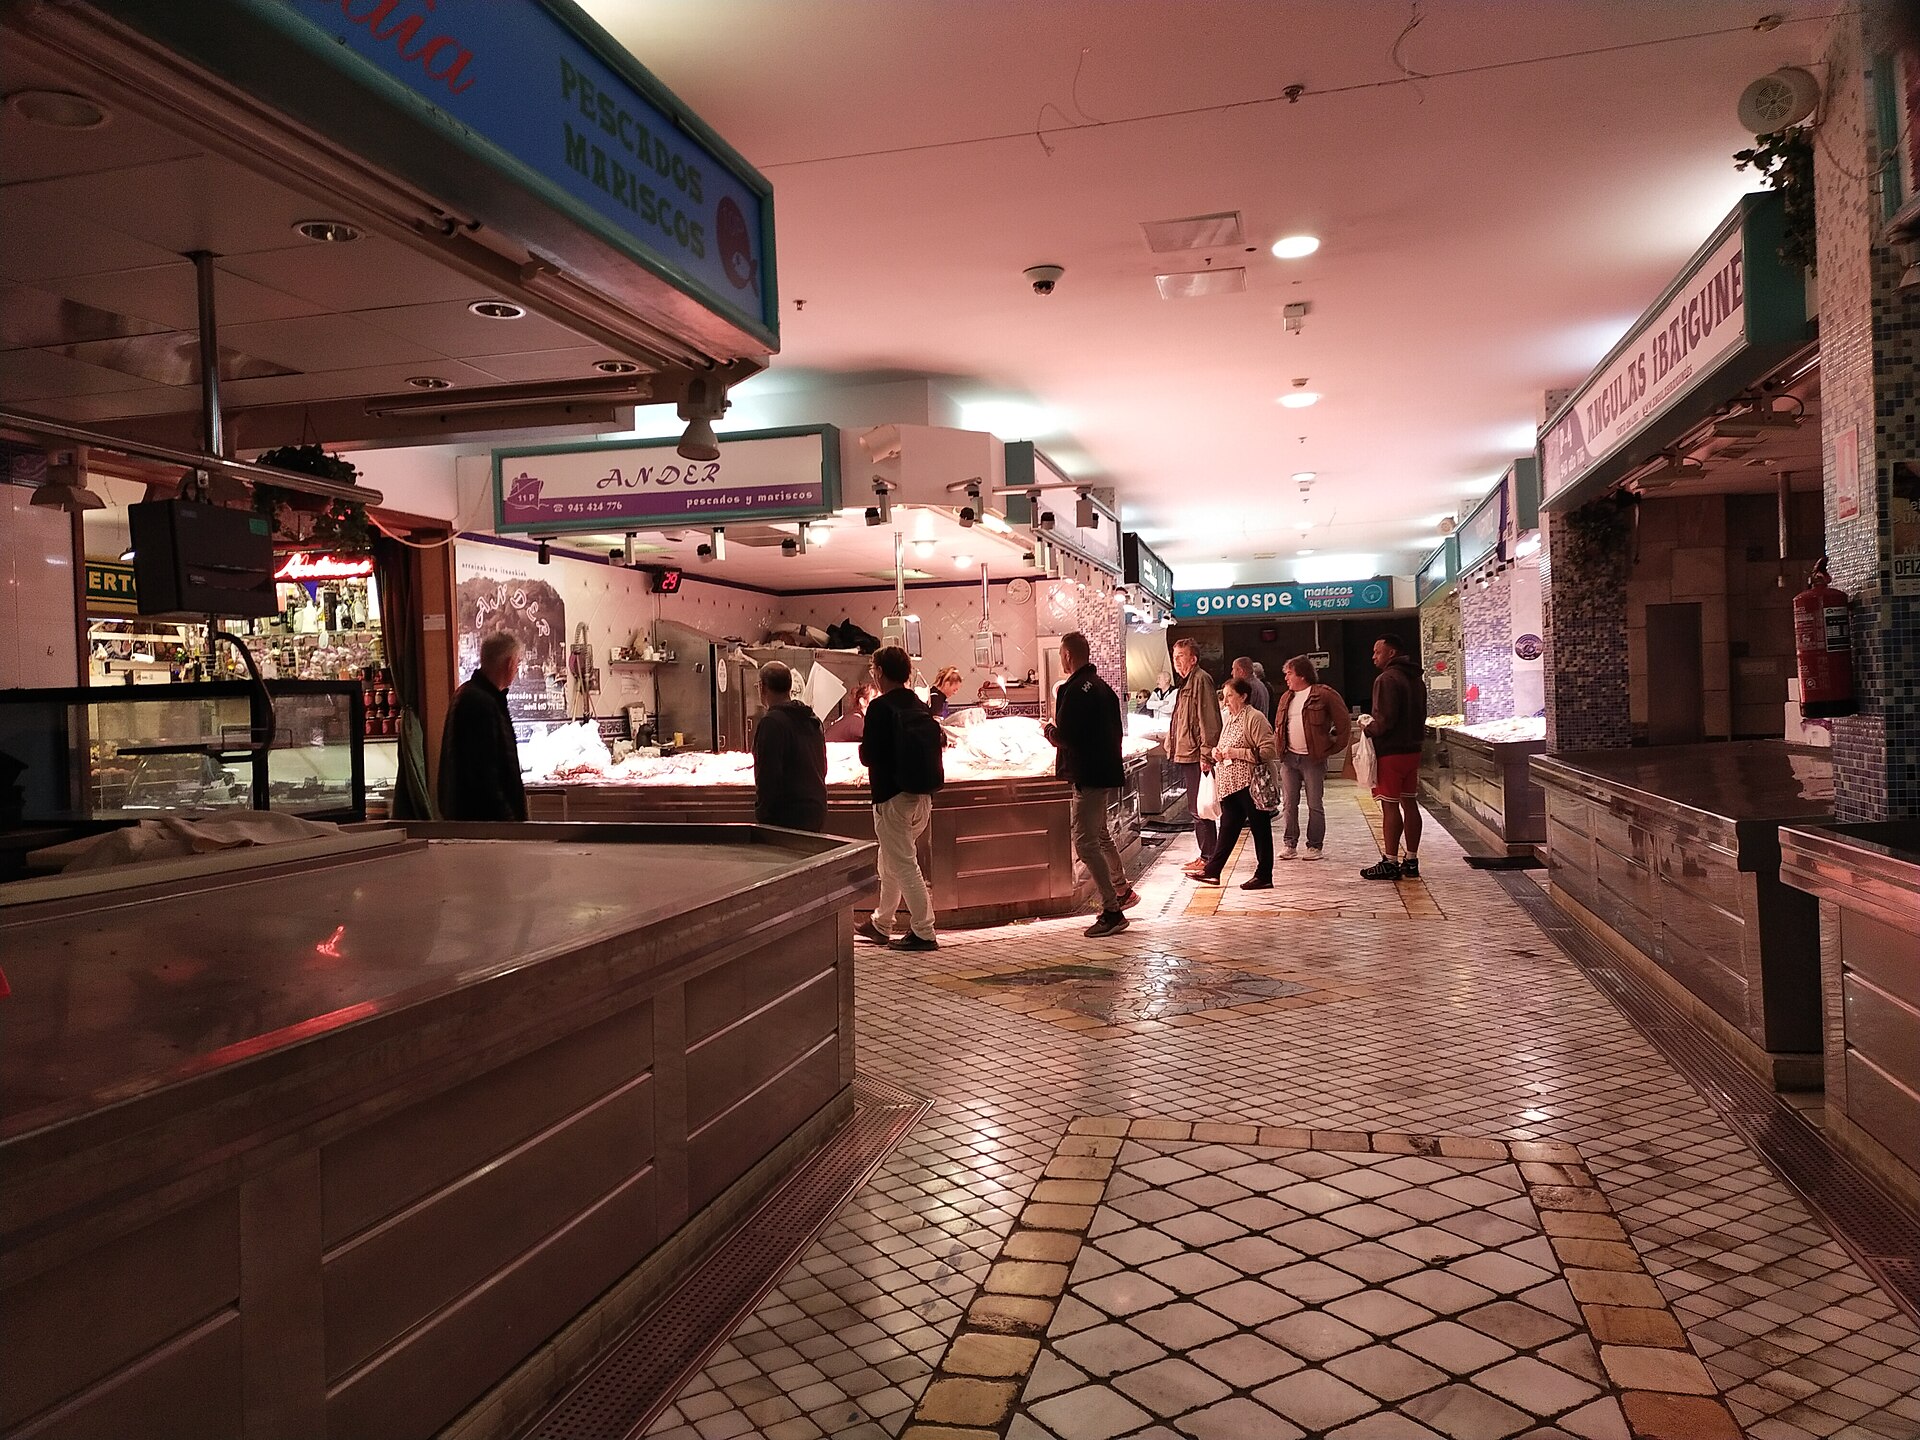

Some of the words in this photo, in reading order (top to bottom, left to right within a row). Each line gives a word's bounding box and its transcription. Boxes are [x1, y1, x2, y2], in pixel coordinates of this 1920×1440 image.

[560, 55, 704, 205] PESCADOS
[564, 122, 705, 259] MARISCOS
[1586, 351, 1647, 444] ANGULAS
[596, 462, 722, 488] ANDER
[568, 503, 584, 513] 943
[587, 502, 604, 512] 424
[606, 501, 622, 510] 776
[686, 494, 740, 509] pescados
[746, 495, 752, 505] y
[758, 490, 813, 502] mariscos
[88, 571, 137, 592] ERT
[662, 573, 678, 590] 29
[1304, 585, 1354, 599] mariscos
[476, 584, 550, 637] ANDER
[1196, 591, 1292, 615] gorospe
[1309, 599, 1322, 608] 943
